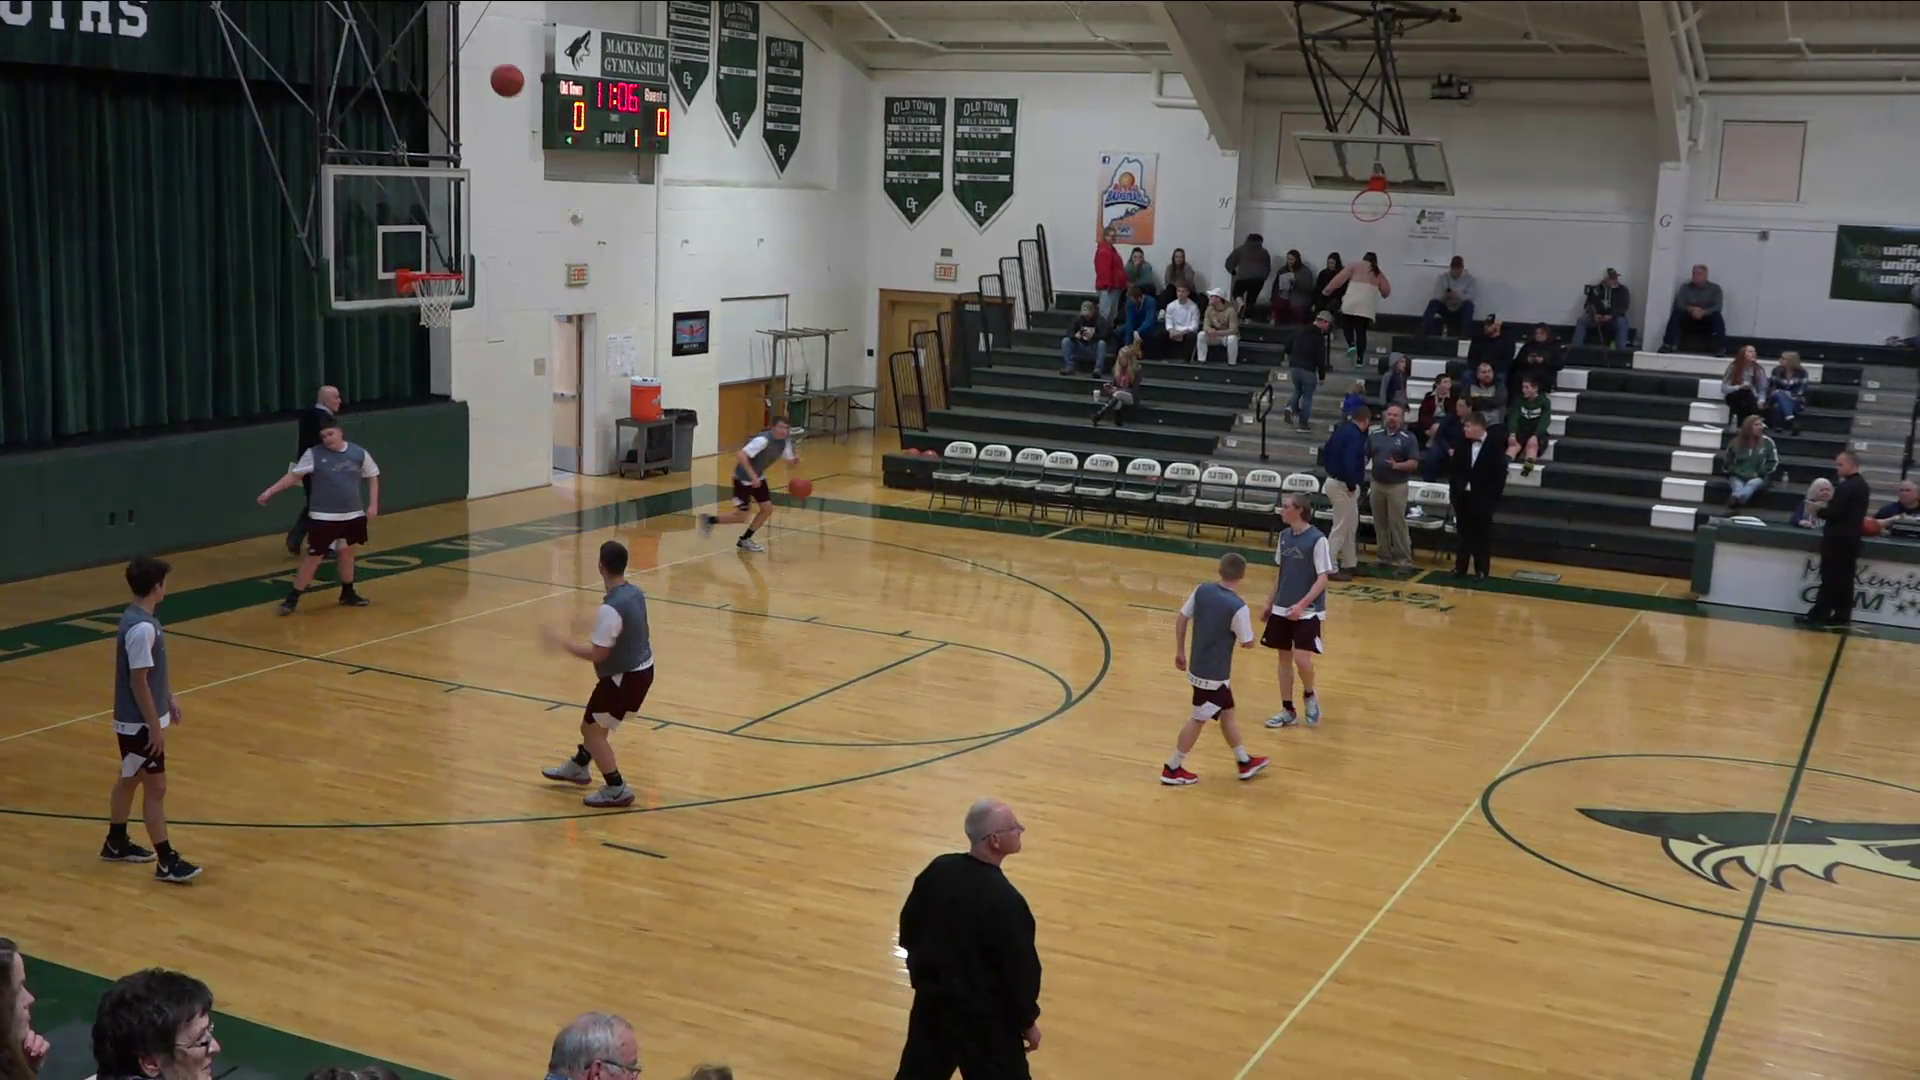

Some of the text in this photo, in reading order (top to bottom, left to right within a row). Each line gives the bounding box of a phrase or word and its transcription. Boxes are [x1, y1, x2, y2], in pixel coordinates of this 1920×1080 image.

[605, 38, 665, 59] MACKENZIE
[604, 57, 665, 77] GYMNASIUM
[597, 81, 640, 112] 11:06
[573, 101, 585, 131] 0
[893, 100, 936, 116] OLD TOWN
[963, 100, 1008, 118] OLD TOWN
[656, 108, 668, 137] 0
[603, 131, 626, 144] period
[634, 129, 639, 148] 1
[1218, 196, 1233, 208] H
[1659, 214, 1673, 228] G
[1802, 585, 1885, 611] GM
